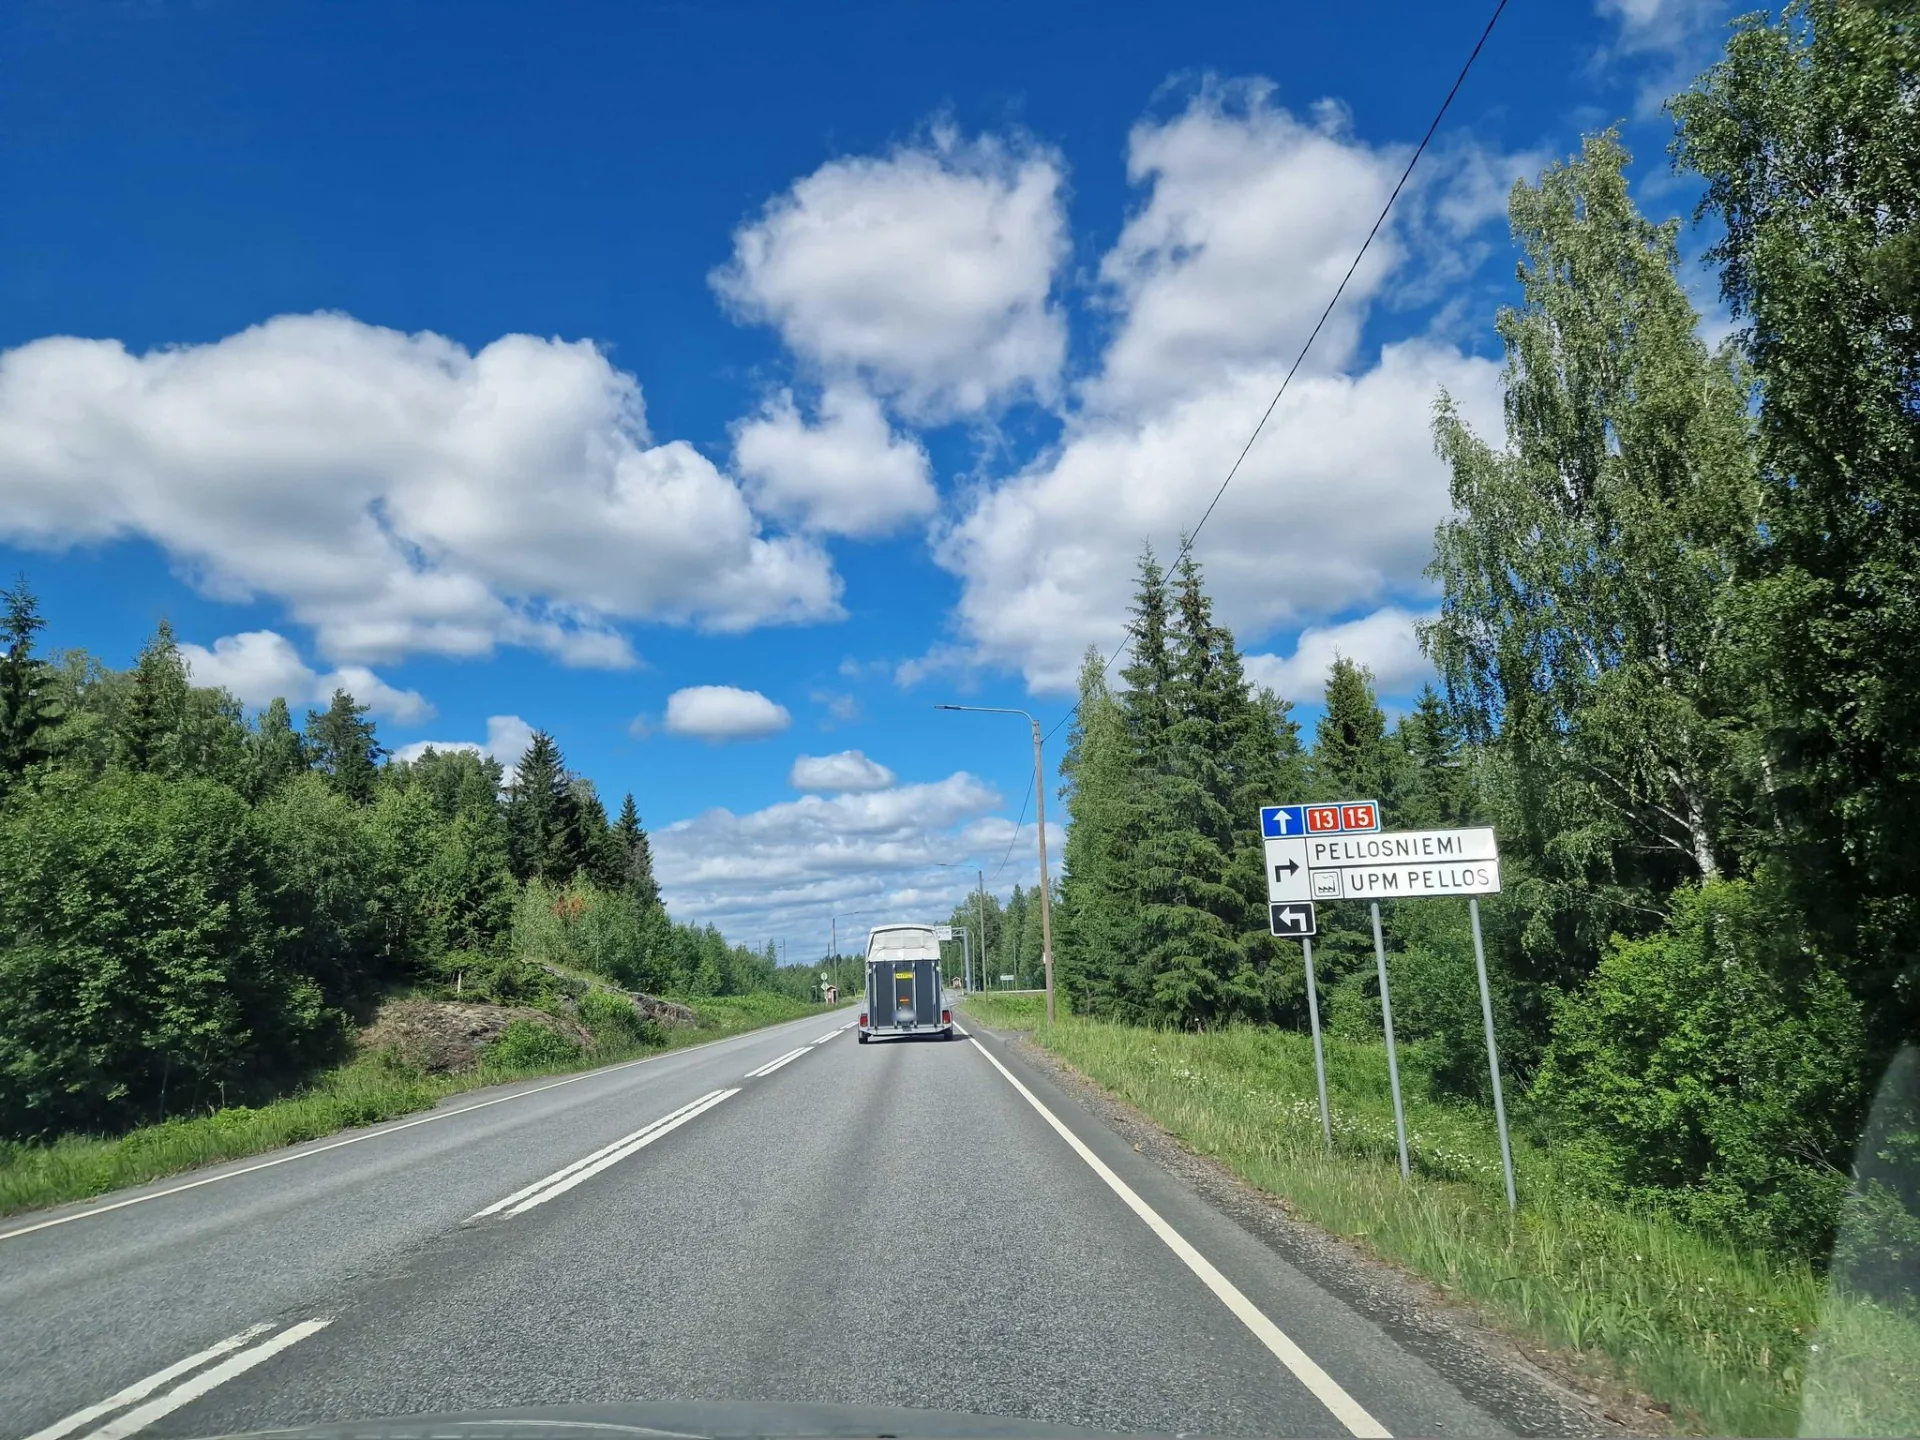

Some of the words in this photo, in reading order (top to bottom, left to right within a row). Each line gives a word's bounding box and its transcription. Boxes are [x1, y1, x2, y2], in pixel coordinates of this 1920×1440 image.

[1313, 810, 1334, 829] 13
[1348, 808, 1370, 827] 15
[1315, 836, 1463, 861] PELLOSNIEMI
[1351, 872, 1398, 891] UPM
[1408, 868, 1490, 889] PELLOS
